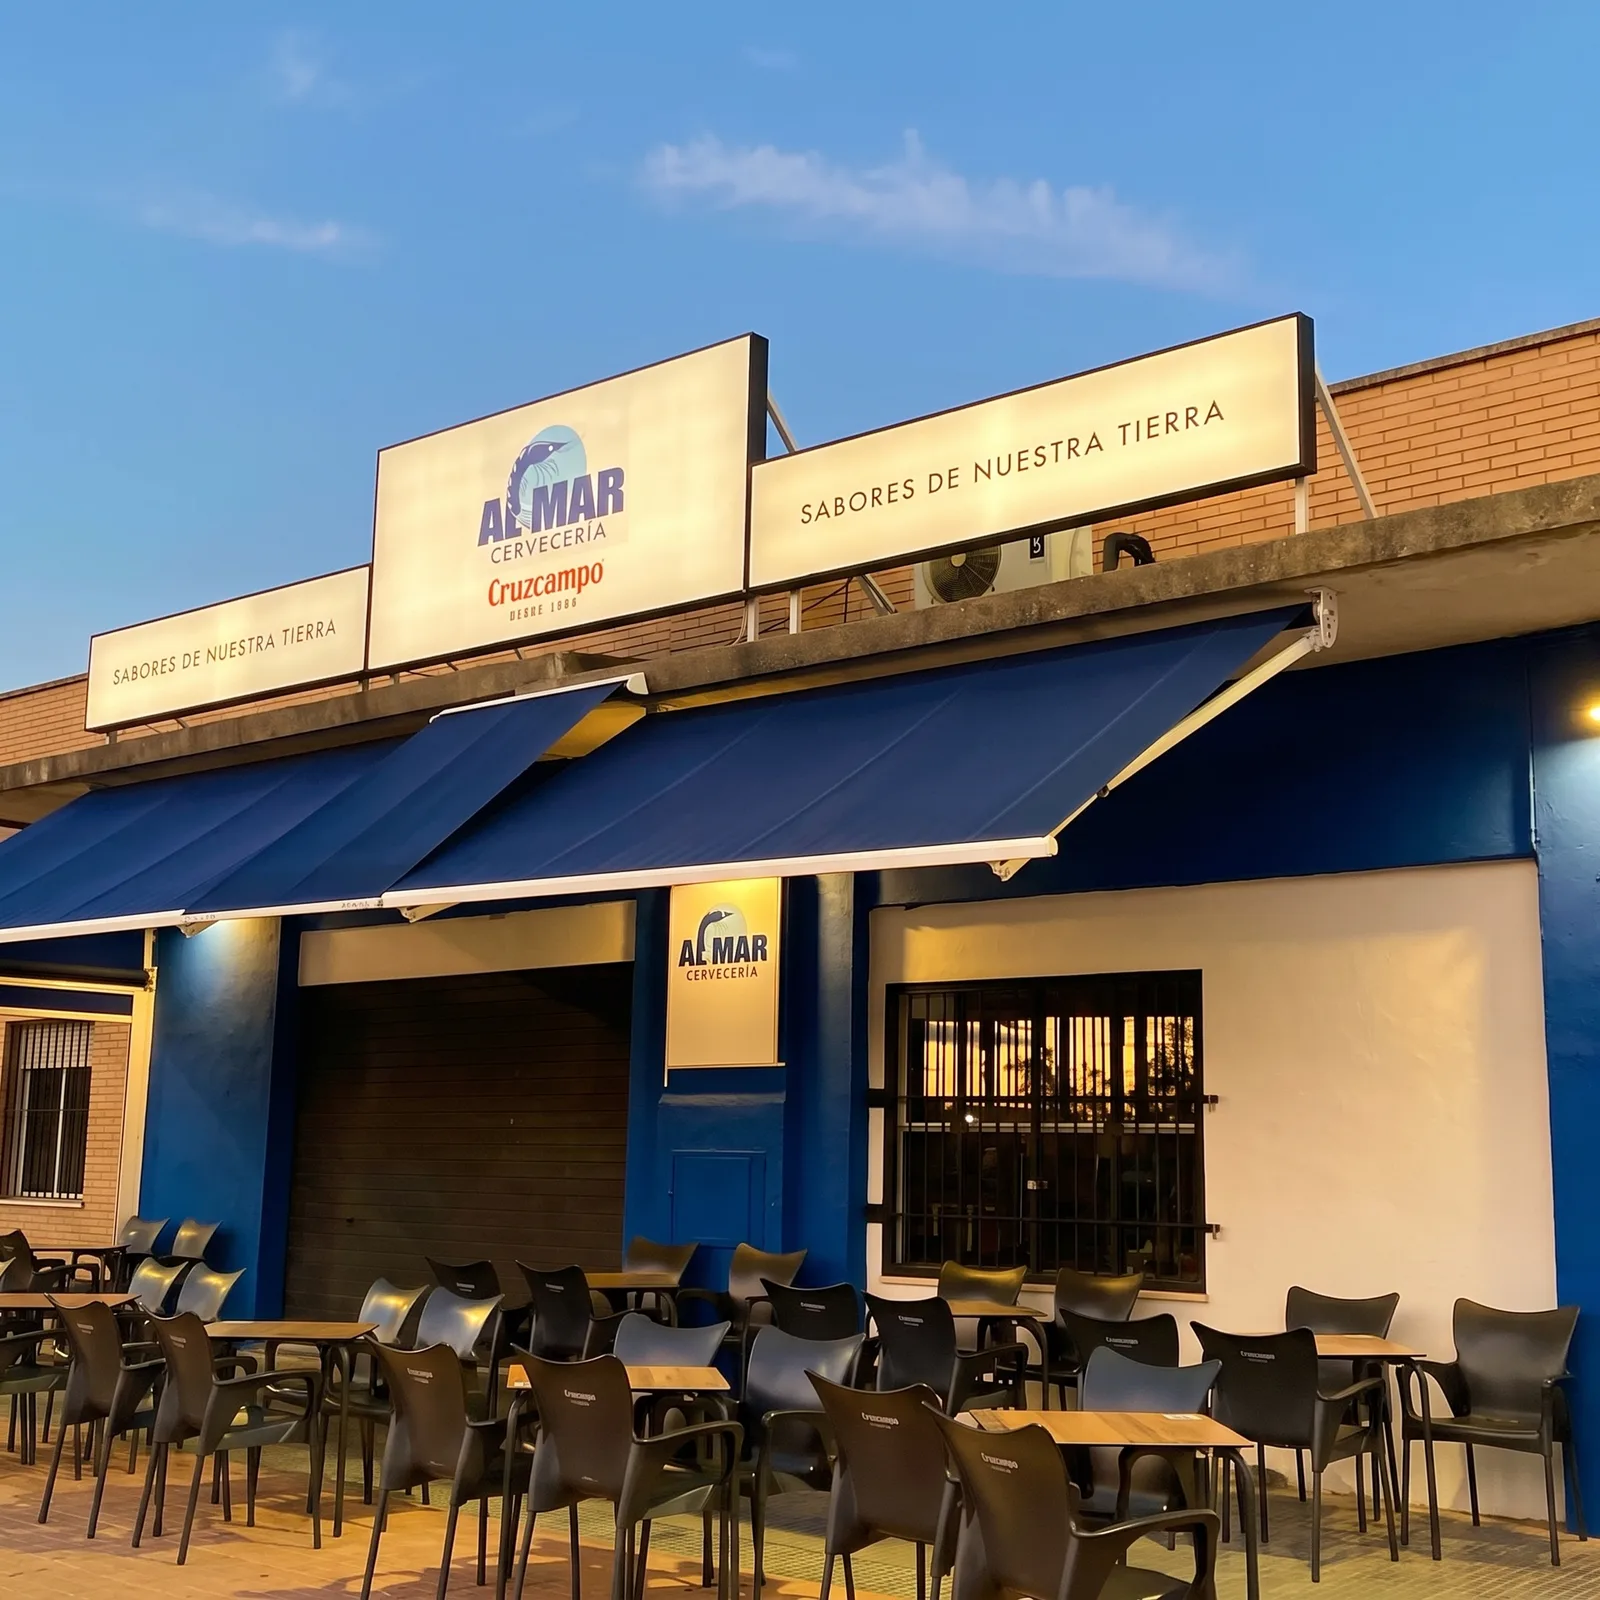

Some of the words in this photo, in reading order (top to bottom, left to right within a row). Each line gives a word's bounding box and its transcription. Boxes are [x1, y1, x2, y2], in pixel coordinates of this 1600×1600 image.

[800, 478, 915, 525] SABORES
[928, 467, 960, 494] DE
[973, 431, 1104, 484] NUESTRA
[1117, 400, 1225, 446] TIERRA
[491, 521, 606, 563] CERVECERÍA
[488, 562, 603, 606] Cruzcampo
[112, 656, 176, 686] SABORES
[182, 650, 200, 670] DE
[206, 633, 275, 664] NUESTRA
[282, 618, 337, 646] TIERRA
[686, 964, 758, 981] CERVECERÍA
